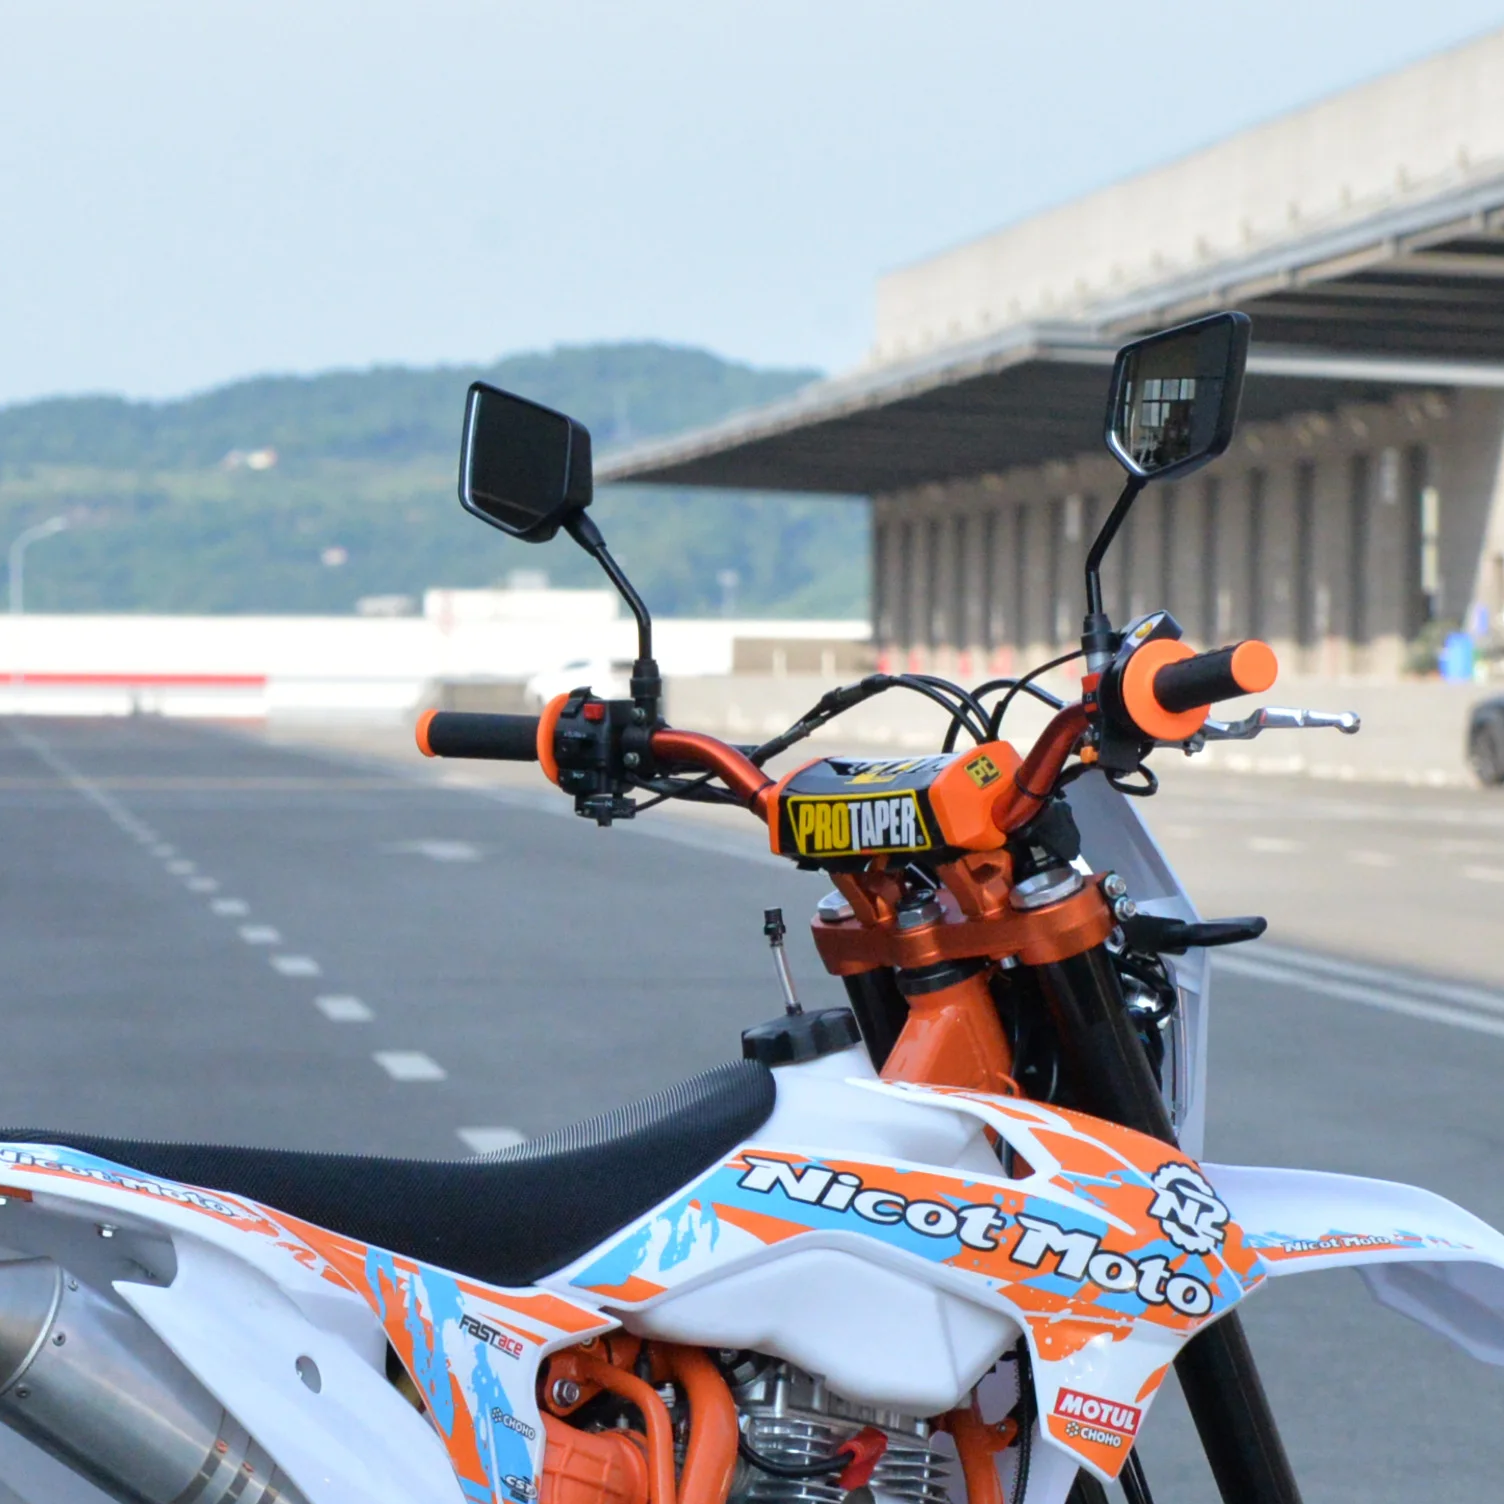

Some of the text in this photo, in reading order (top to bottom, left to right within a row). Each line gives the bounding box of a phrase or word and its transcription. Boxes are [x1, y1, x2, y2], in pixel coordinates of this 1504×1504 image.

[799, 796, 917, 854] PROTAPER
[737, 1155, 1214, 1316] Nicot Moto
[1281, 1235, 1392, 1253] Nicot Moto
[502, 1415, 536, 1440] CHOHO
[1059, 1393, 1136, 1431] MOTUL
[1080, 1427, 1122, 1448] CHOHO
